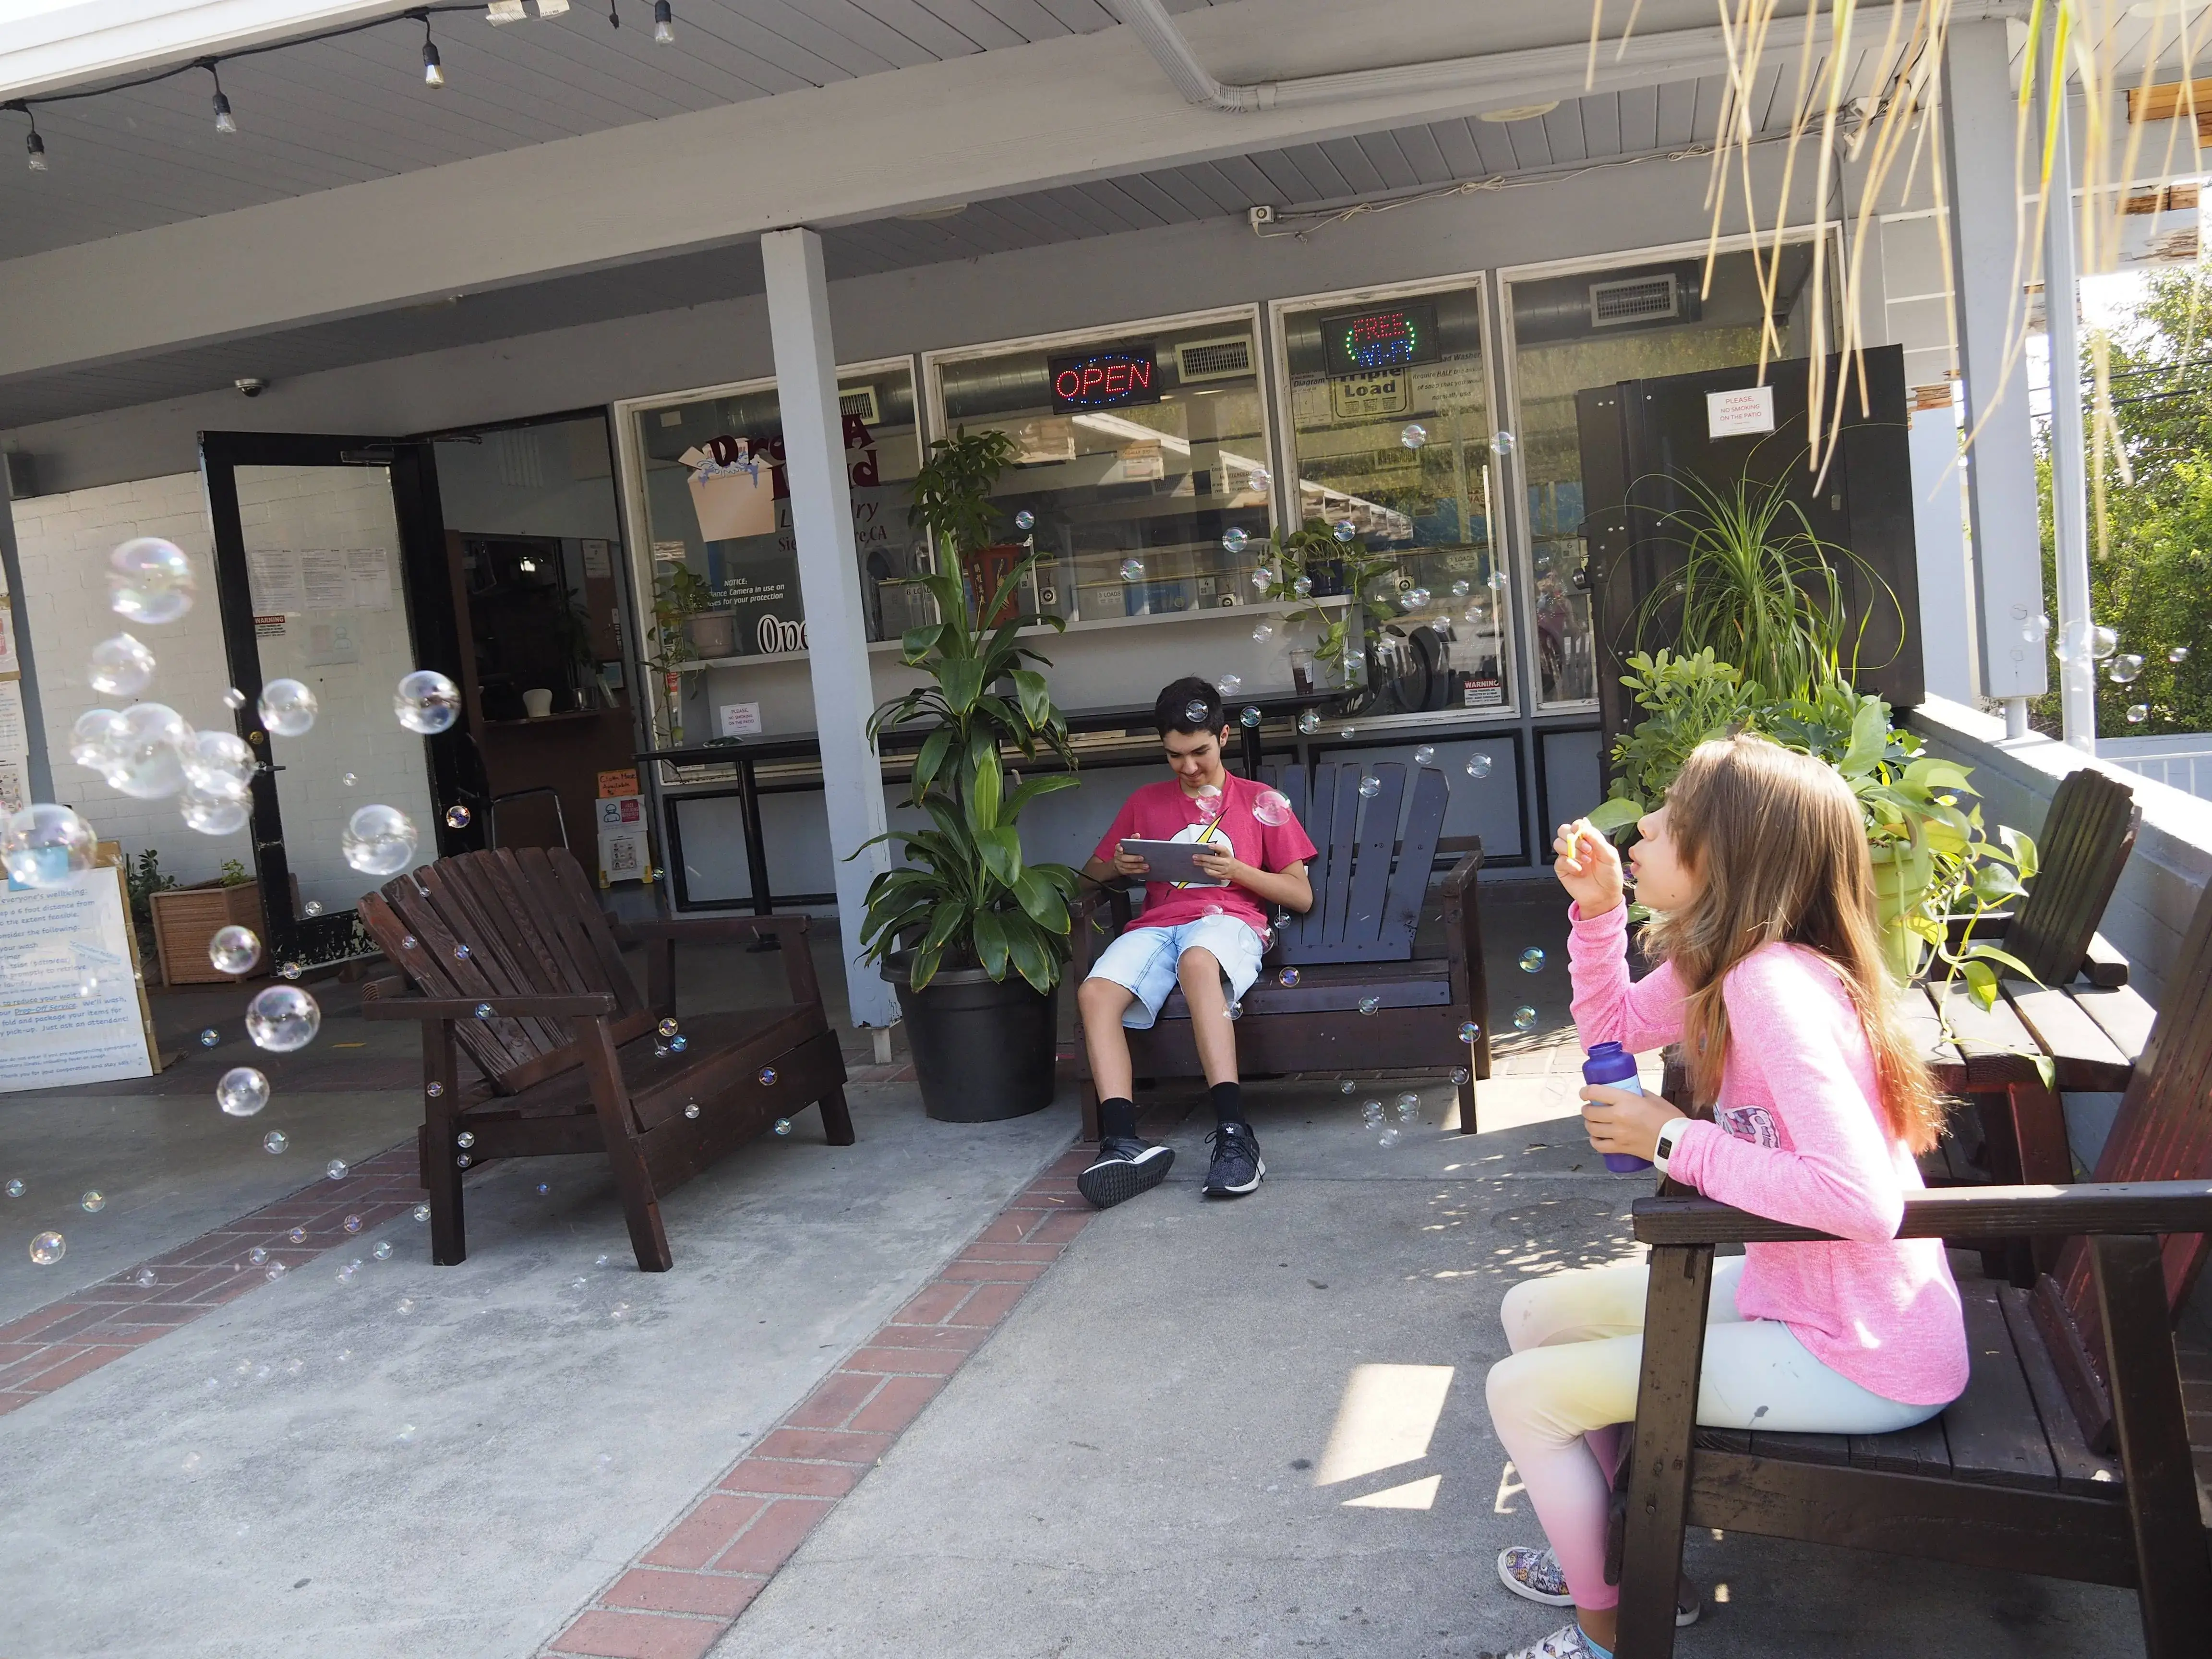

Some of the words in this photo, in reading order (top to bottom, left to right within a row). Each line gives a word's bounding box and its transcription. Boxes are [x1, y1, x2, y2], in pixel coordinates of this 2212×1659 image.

[1353, 313, 1405, 341] FREE
[1437, 369, 1452, 377] HALF
[1057, 361, 1150, 397] OPEN
[1294, 377, 1325, 387] Diagram
[1345, 379, 1395, 397] Load
[1725, 396, 1754, 404] PLEASE,
[705, 434, 786, 466] Dro
[841, 413, 875, 449] A
[724, 578, 747, 587] NOTICE:
[729, 587, 753, 595] Camera
[734, 596, 748, 604] your
[750, 593, 783, 603] protection
[757, 614, 808, 653] Ope
[1465, 680, 1499, 688] WARNING
[1, 893, 44, 903] everyone's
[47, 889, 88, 899] wellbeing:
[42, 903, 74, 911] distance
[22, 915, 46, 924] extent
[42, 925, 80, 934] following:
[10, 969, 44, 979] promptly
[14, 1006, 47, 1015] Drop-Off
[35, 1014, 66, 1023] package
[6, 1027, 37, 1036] pick-up.
[87, 1016, 129, 1026] attendant!
